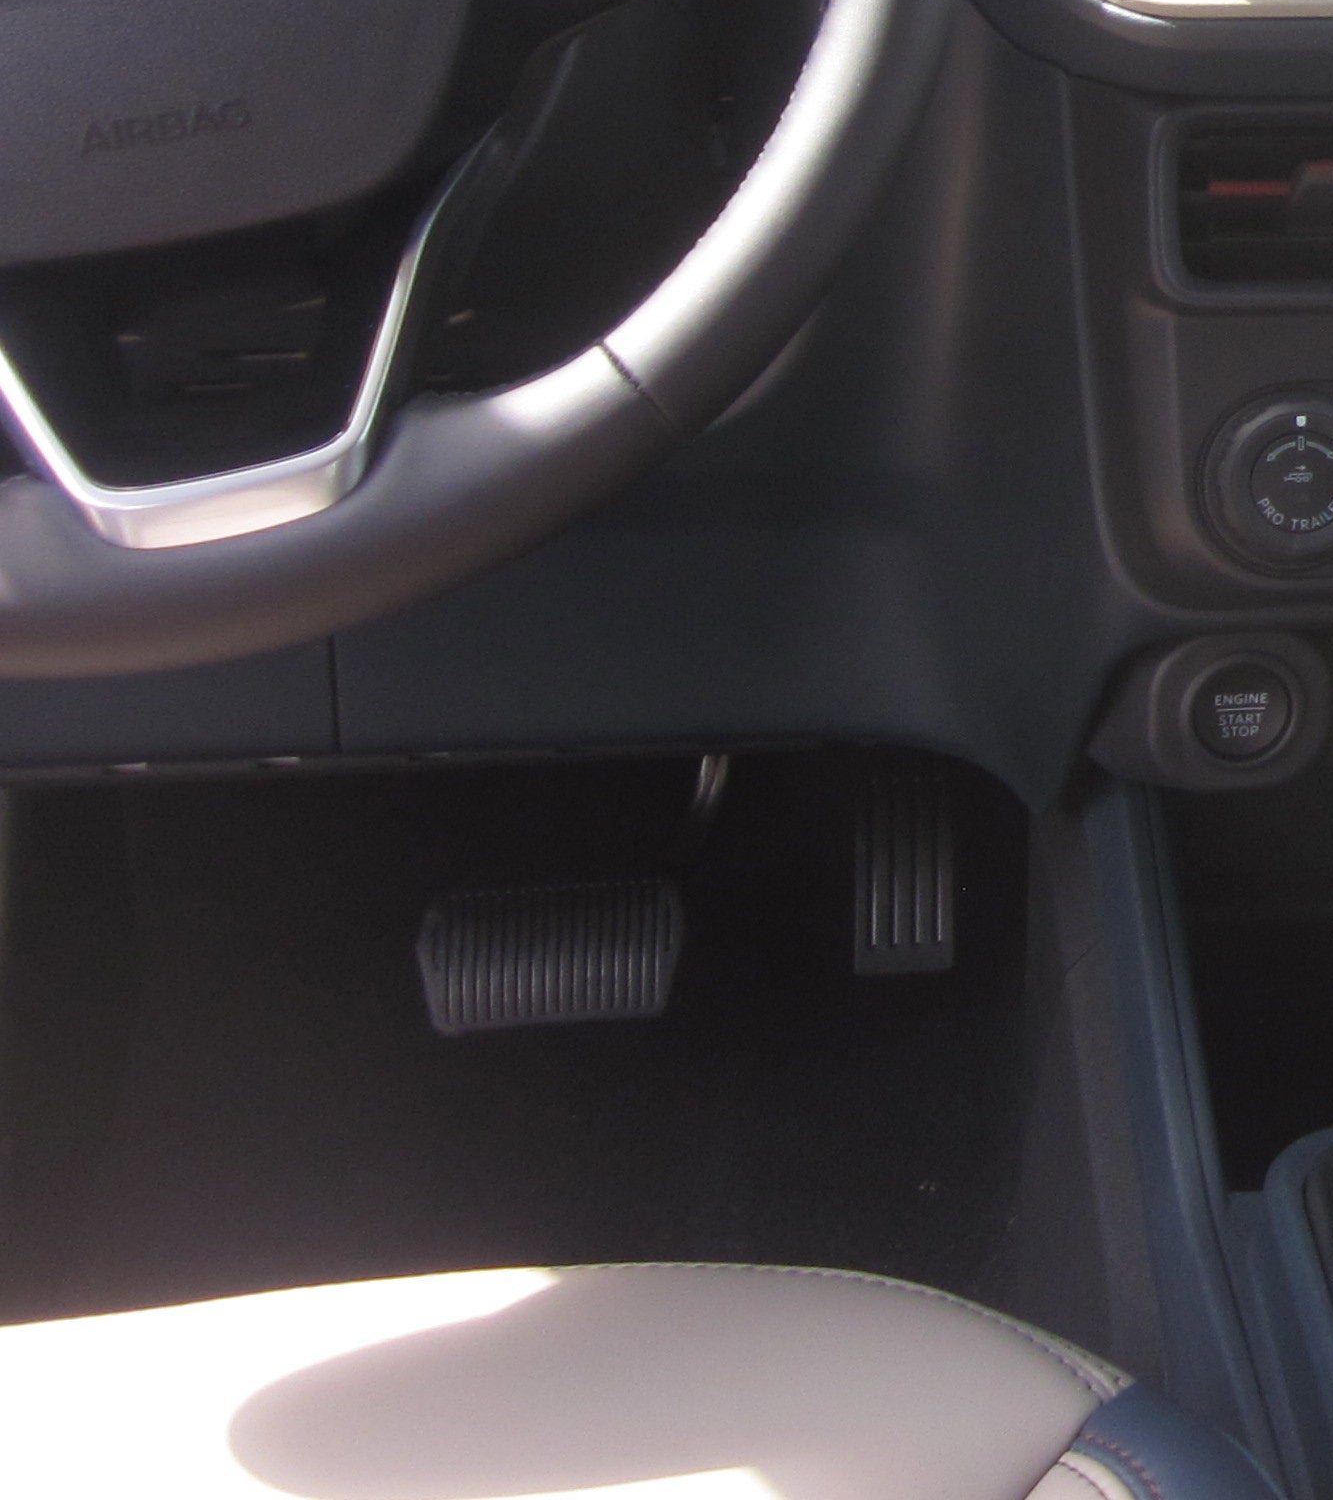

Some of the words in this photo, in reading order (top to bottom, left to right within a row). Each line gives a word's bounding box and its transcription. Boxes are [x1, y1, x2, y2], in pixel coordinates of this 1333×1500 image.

[79, 99, 253, 158] AIRBAG
[1256, 497, 1285, 526] PRO
[1214, 692, 1269, 706] ENGINE
[1218, 712, 1263, 726] START
[1221, 725, 1260, 738] STOP
